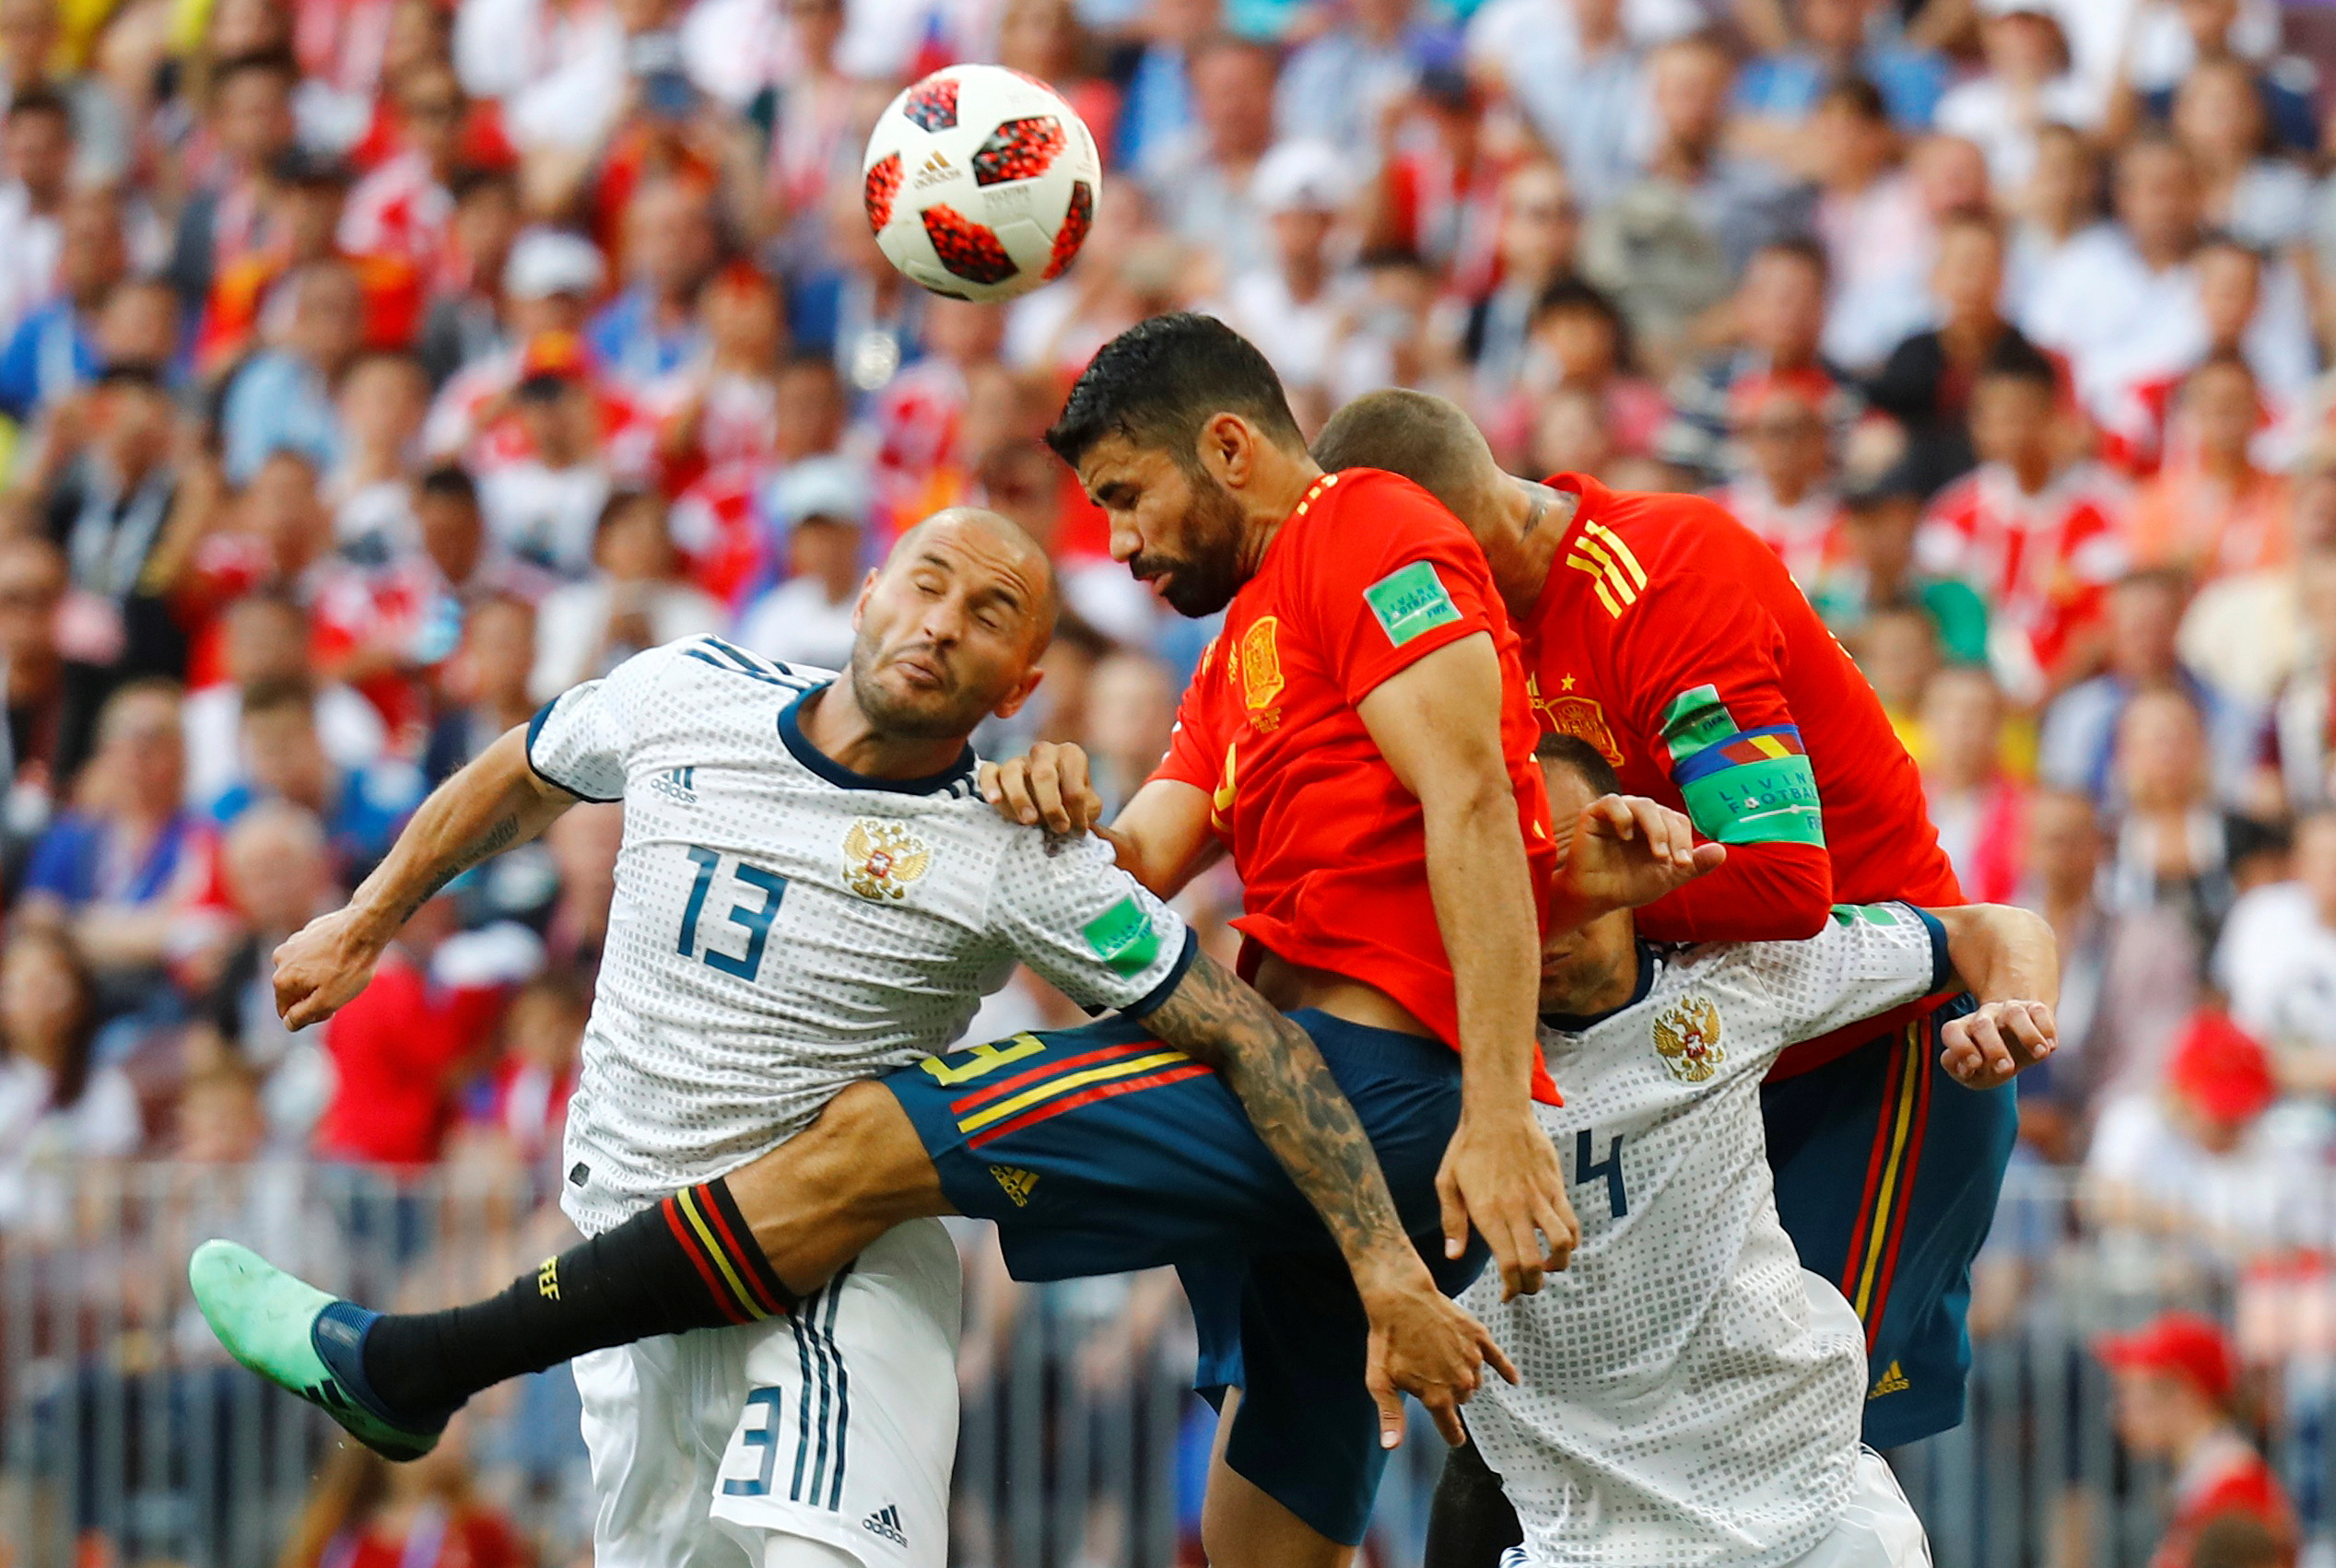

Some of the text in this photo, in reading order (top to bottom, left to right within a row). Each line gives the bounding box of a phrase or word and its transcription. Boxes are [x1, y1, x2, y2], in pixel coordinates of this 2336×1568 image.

[650, 778, 698, 803] adidas
[677, 845, 789, 983] 13
[989, 1165, 1029, 1209] adidas
[1576, 1129, 1628, 1219] 4
[722, 1386, 782, 1496] 3
[862, 1518, 910, 1550] adidas
